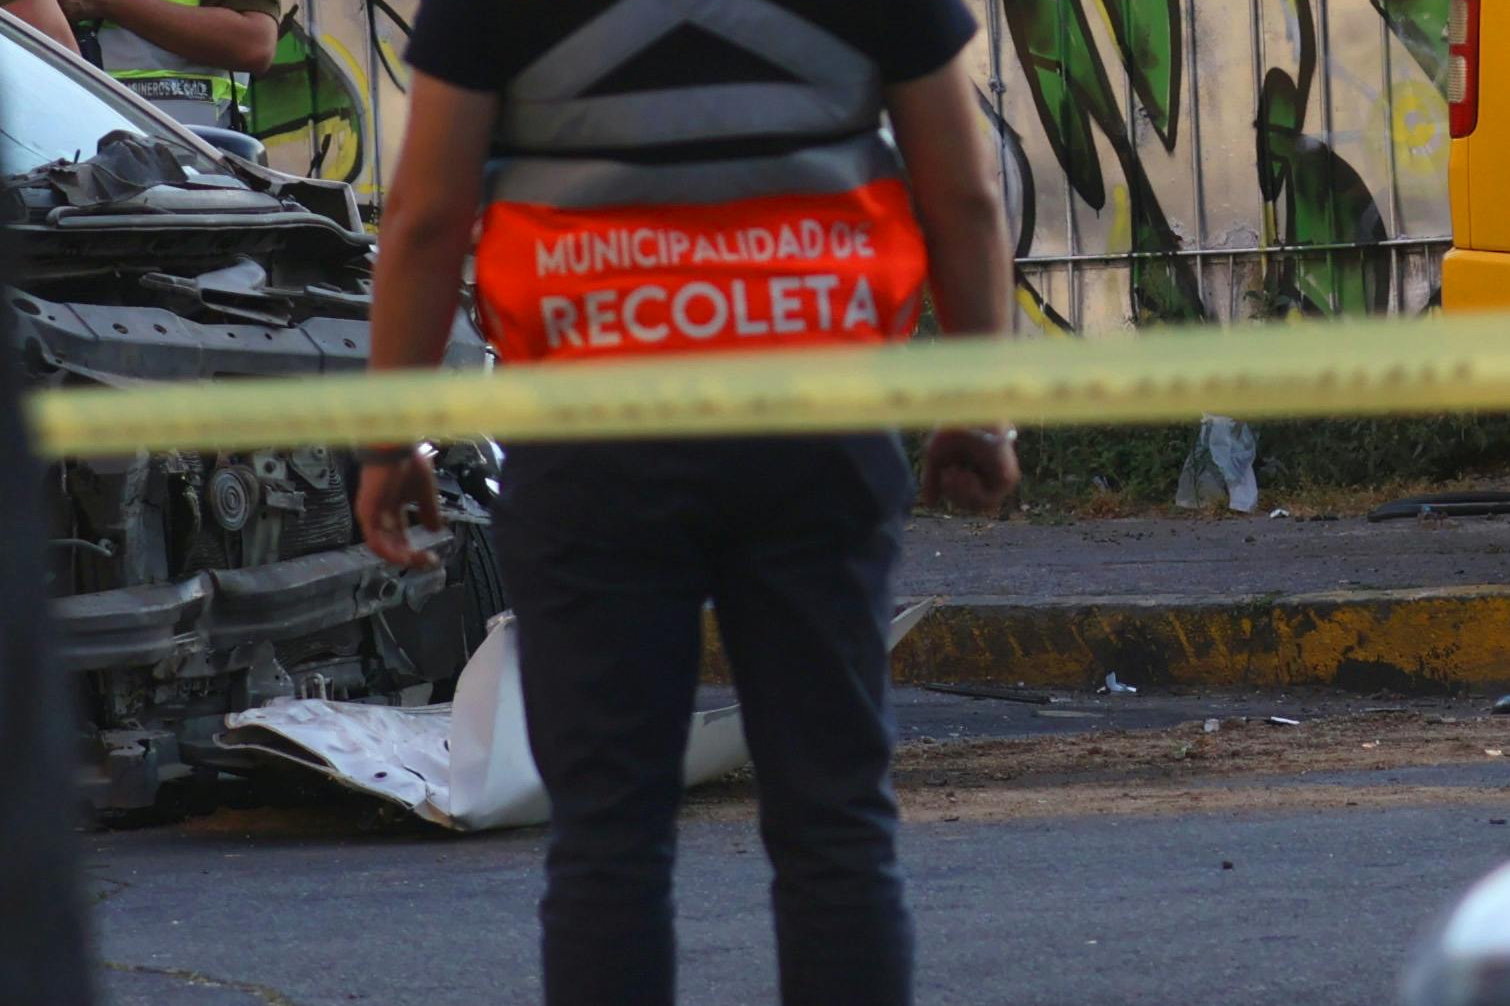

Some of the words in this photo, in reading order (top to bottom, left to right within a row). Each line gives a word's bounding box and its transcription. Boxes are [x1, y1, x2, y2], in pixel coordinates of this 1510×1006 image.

[535, 219, 825, 277] MUNICIPALIDAD
[830, 221, 876, 261] DE
[540, 274, 879, 348] RECOLETA
